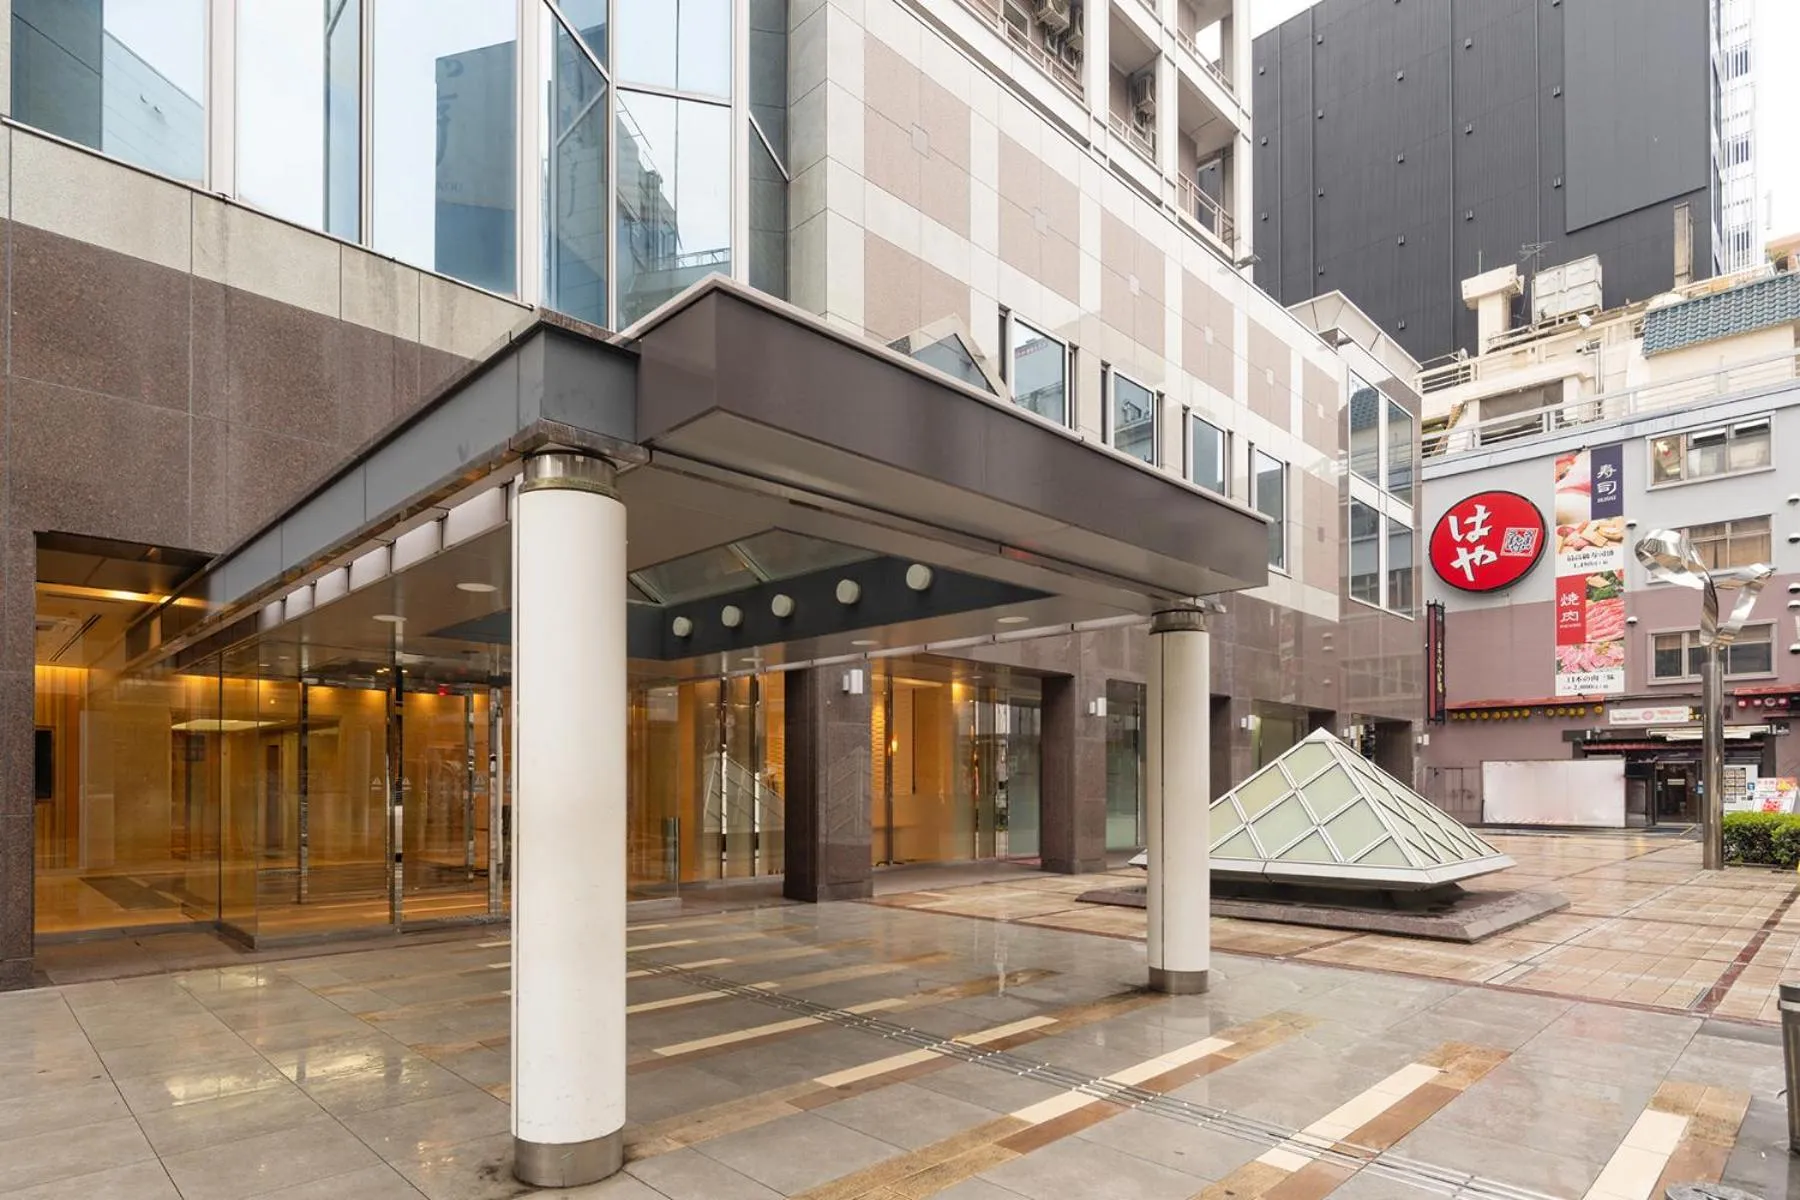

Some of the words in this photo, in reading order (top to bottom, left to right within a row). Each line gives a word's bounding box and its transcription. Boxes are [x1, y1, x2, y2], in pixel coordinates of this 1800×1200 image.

[1597, 463, 1617, 495] 寿司
[1447, 503, 1498, 582] はや
[1560, 591, 1580, 622] 焼肉
